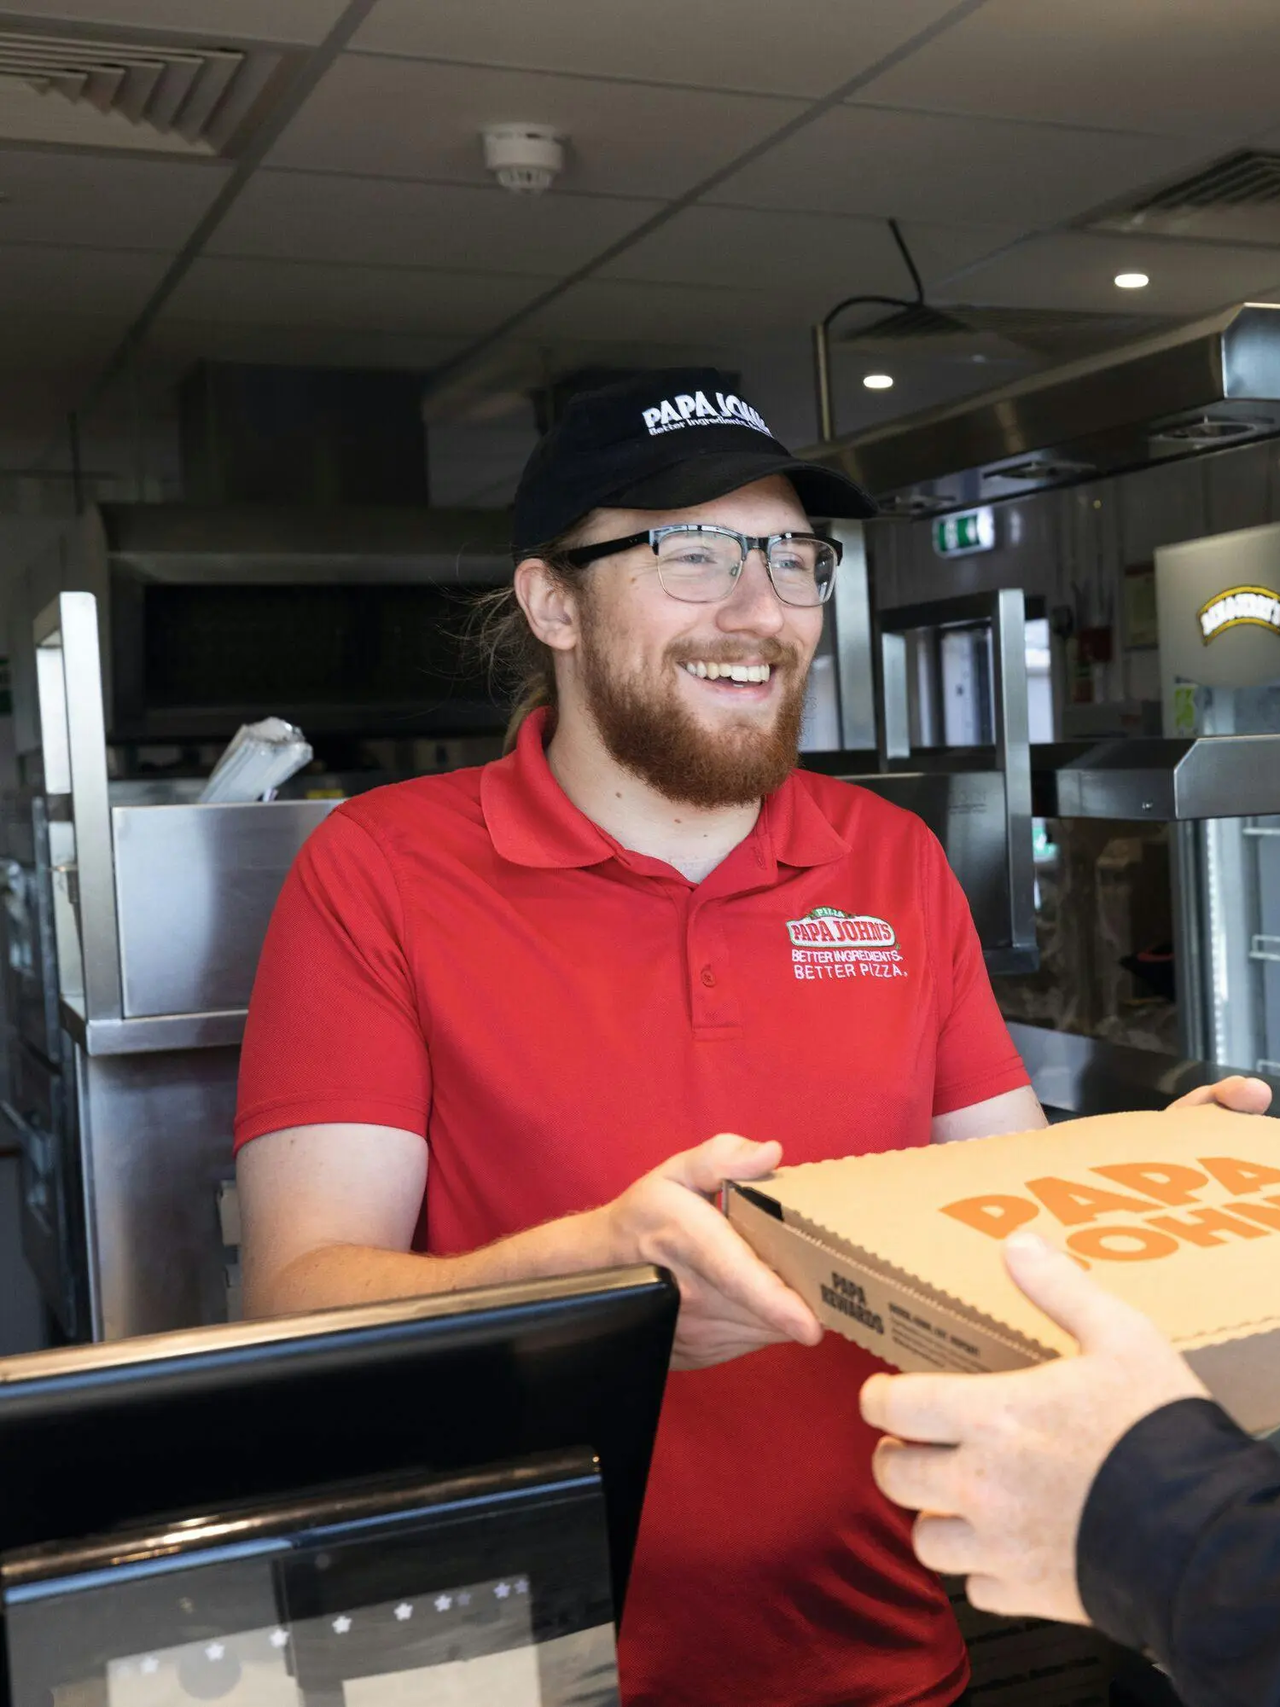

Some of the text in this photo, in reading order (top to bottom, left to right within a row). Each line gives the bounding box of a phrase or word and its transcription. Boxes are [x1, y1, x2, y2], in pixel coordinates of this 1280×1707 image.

[642, 391, 720, 428] PAPA
[791, 920, 836, 942] PAPA
[792, 948, 832, 962] BETTER
[794, 964, 856, 979] BETTER
